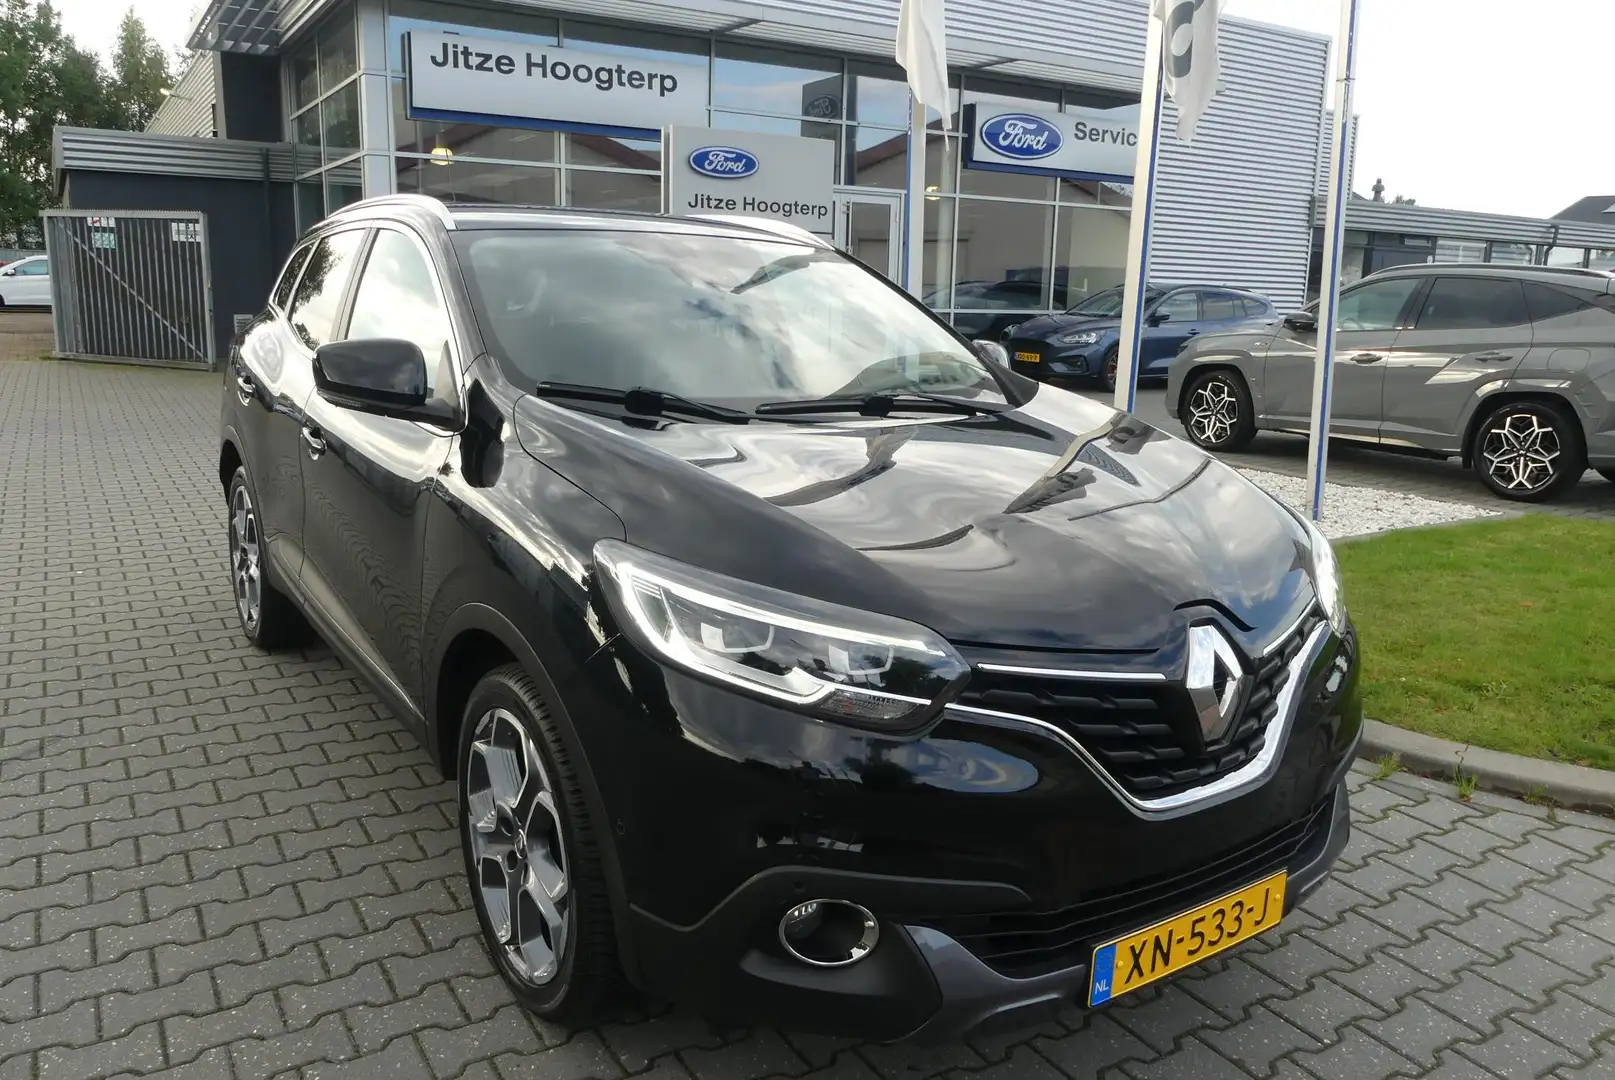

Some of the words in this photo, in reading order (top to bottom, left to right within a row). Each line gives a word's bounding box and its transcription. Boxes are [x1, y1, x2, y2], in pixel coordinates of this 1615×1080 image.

[430, 42, 516, 75] Jitze
[525, 52, 678, 97] Hoogterp
[998, 119, 1049, 151] Ford
[1074, 121, 1137, 147] Servic
[704, 151, 746, 173] Ford
[688, 193, 737, 211] Jitze
[743, 196, 828, 219] Hoogterp
[1124, 887, 1270, 985] XN-533-J
[1094, 978, 1110, 995] NL
